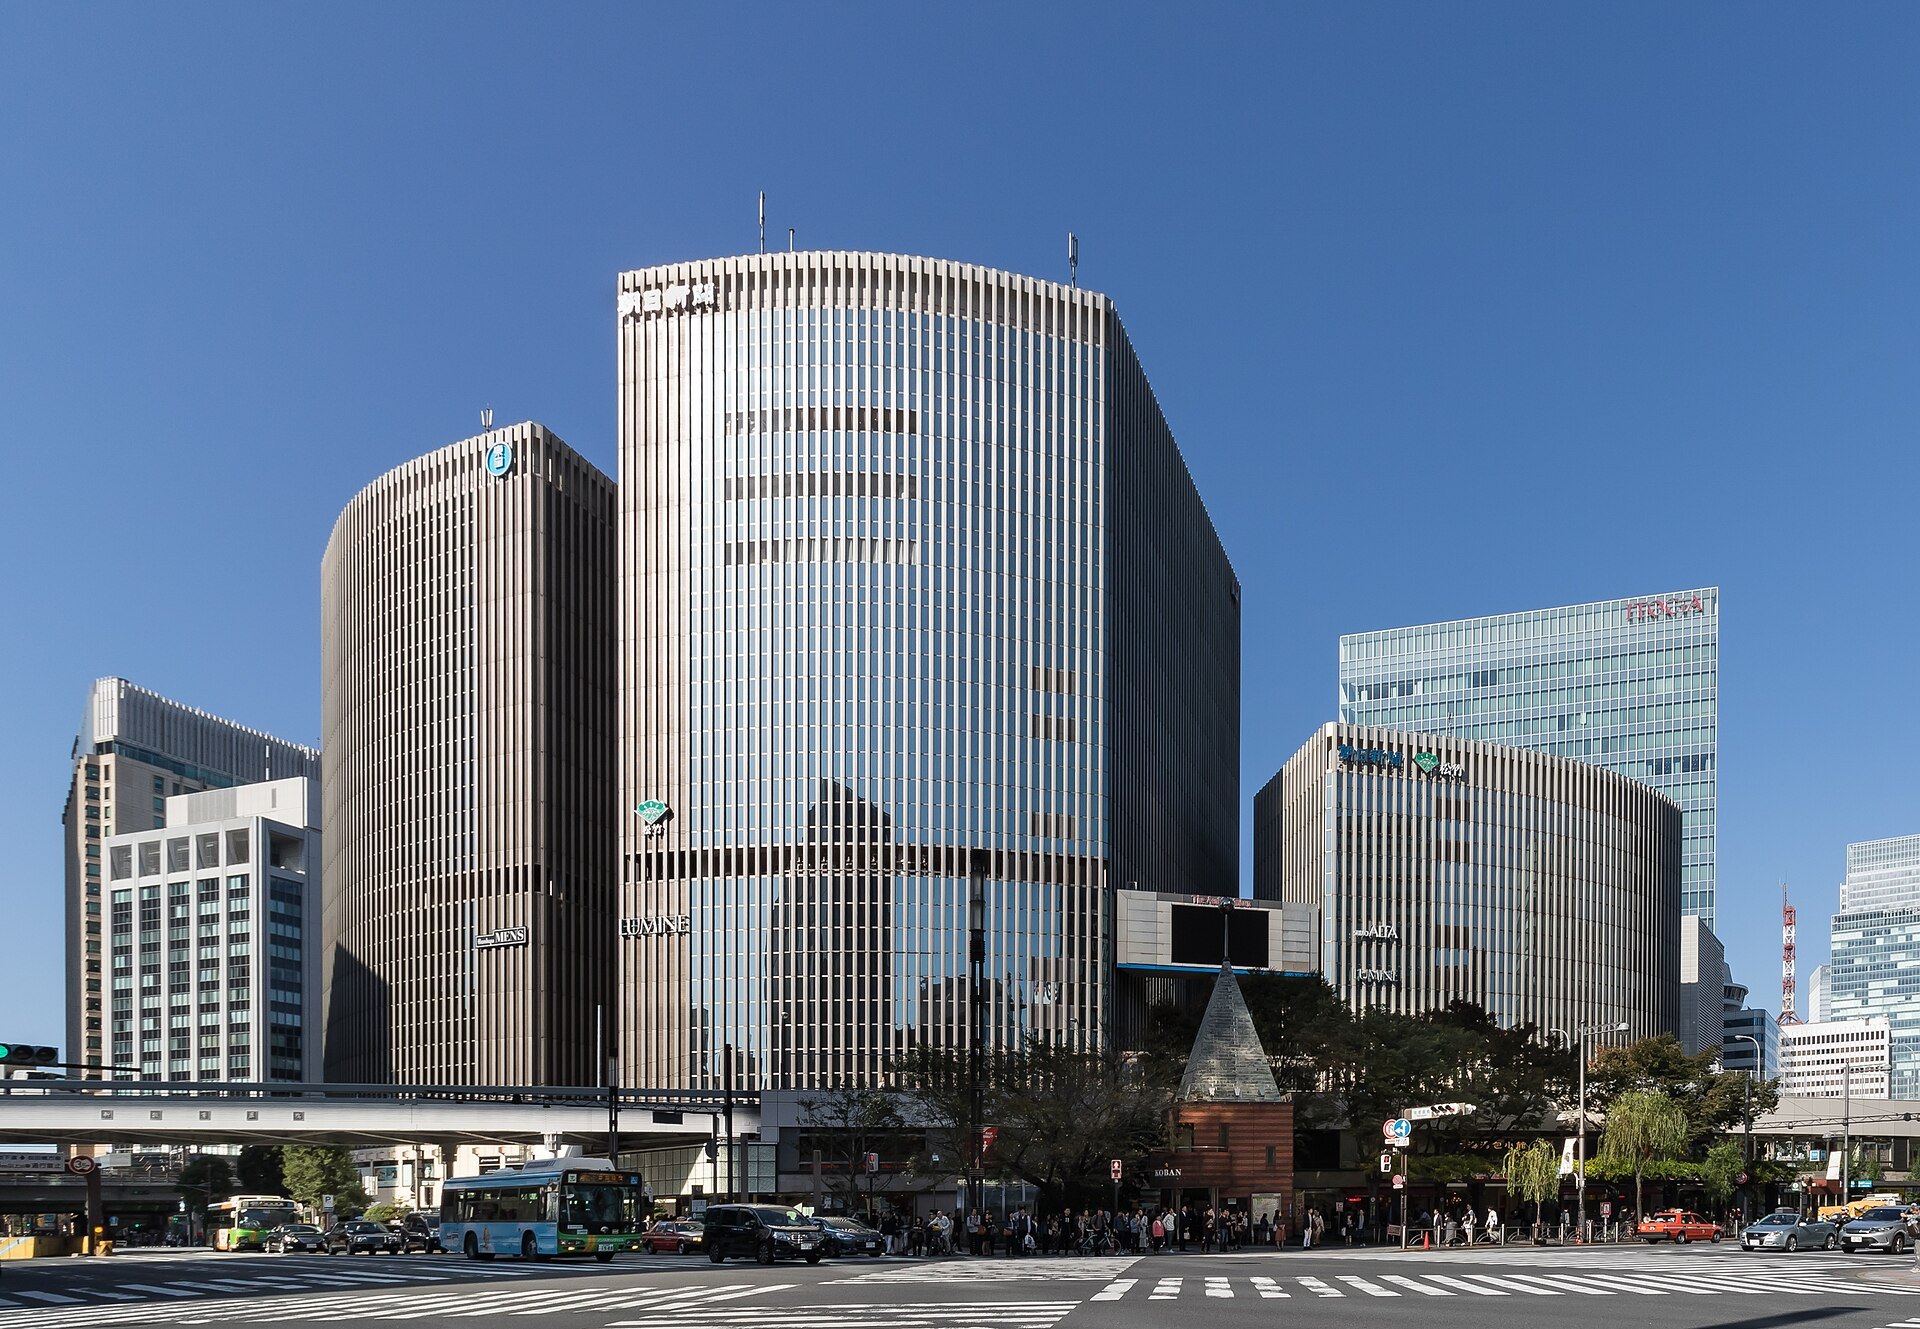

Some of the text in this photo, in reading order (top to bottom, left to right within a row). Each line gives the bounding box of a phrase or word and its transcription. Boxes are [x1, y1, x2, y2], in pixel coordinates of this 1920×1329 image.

[618, 914, 691, 936] LUMINE
[495, 929, 524, 944] MENS
[1154, 1168, 1182, 1177] KOBAN
